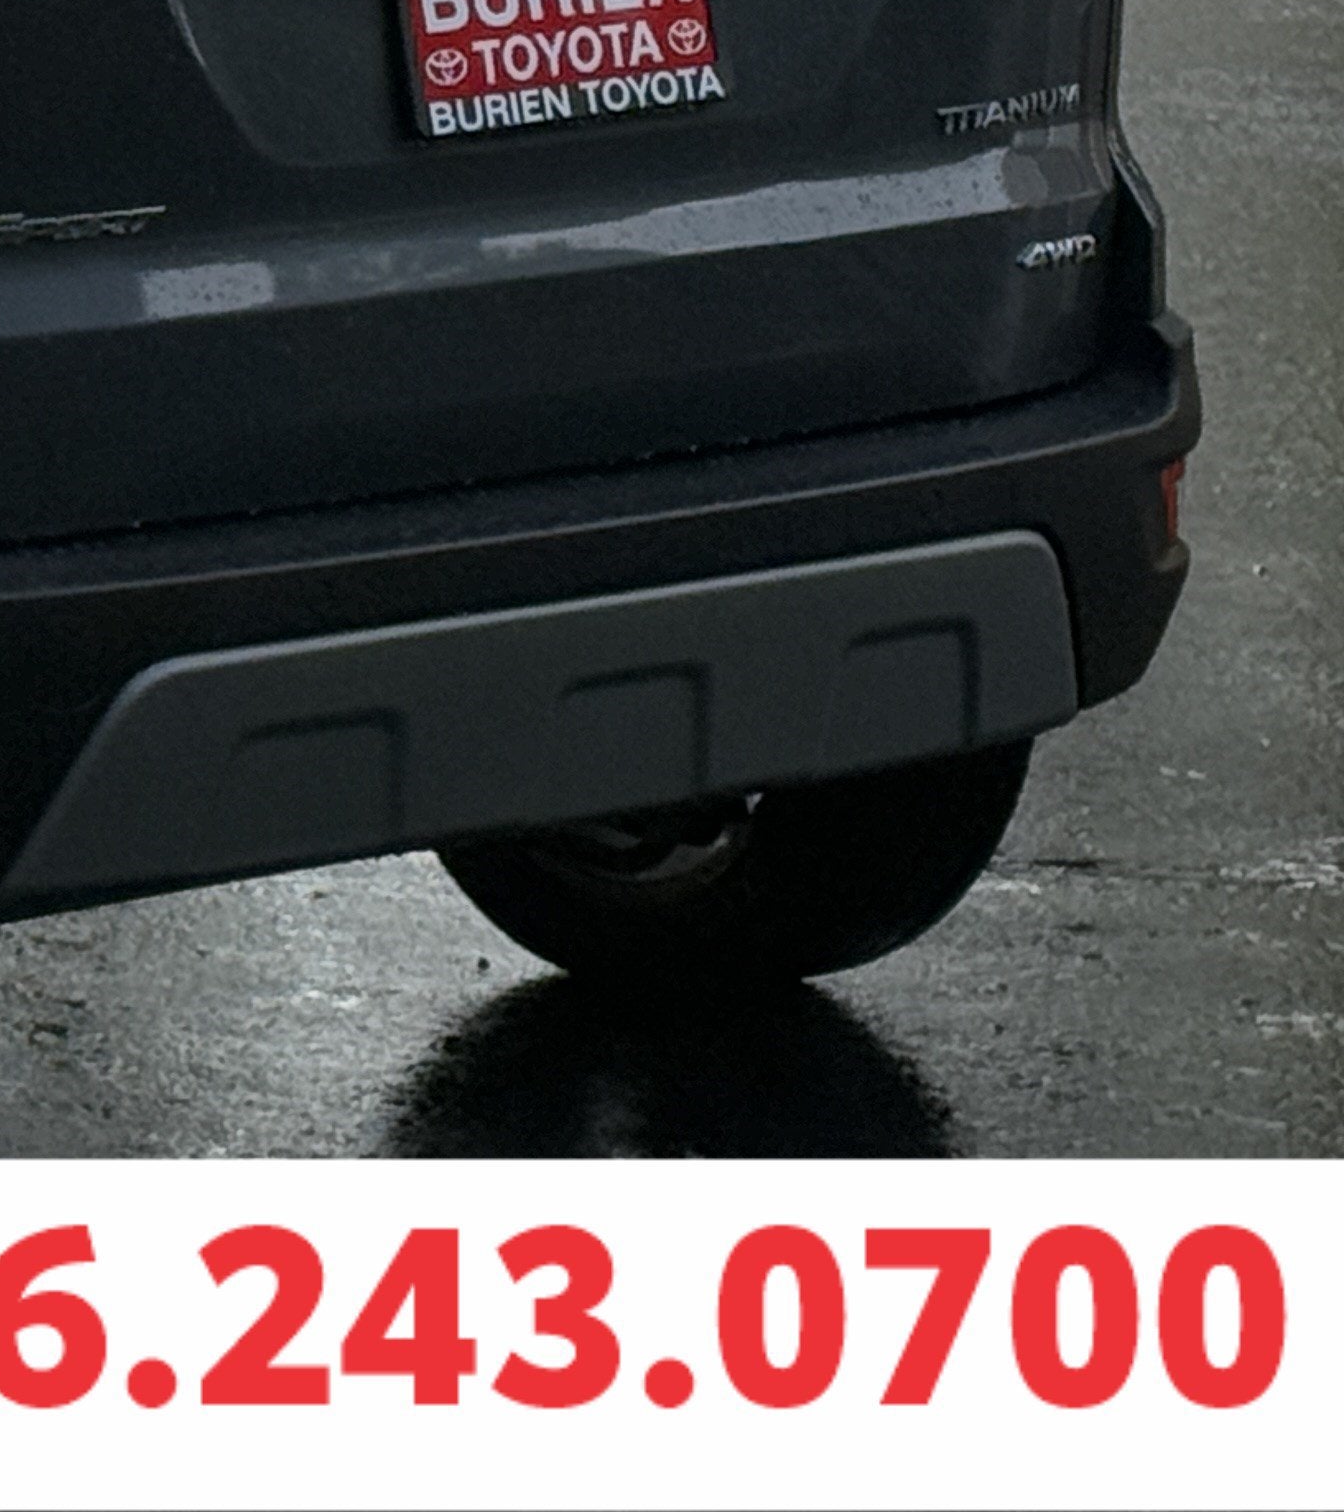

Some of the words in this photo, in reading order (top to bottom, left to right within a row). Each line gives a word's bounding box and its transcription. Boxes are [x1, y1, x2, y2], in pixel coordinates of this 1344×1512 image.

[471, 19, 665, 86] TOYOTA
[427, 86, 573, 137] BURIEN
[578, 64, 727, 117] TOYOTA
[936, 83, 1081, 136] TITANIUM
